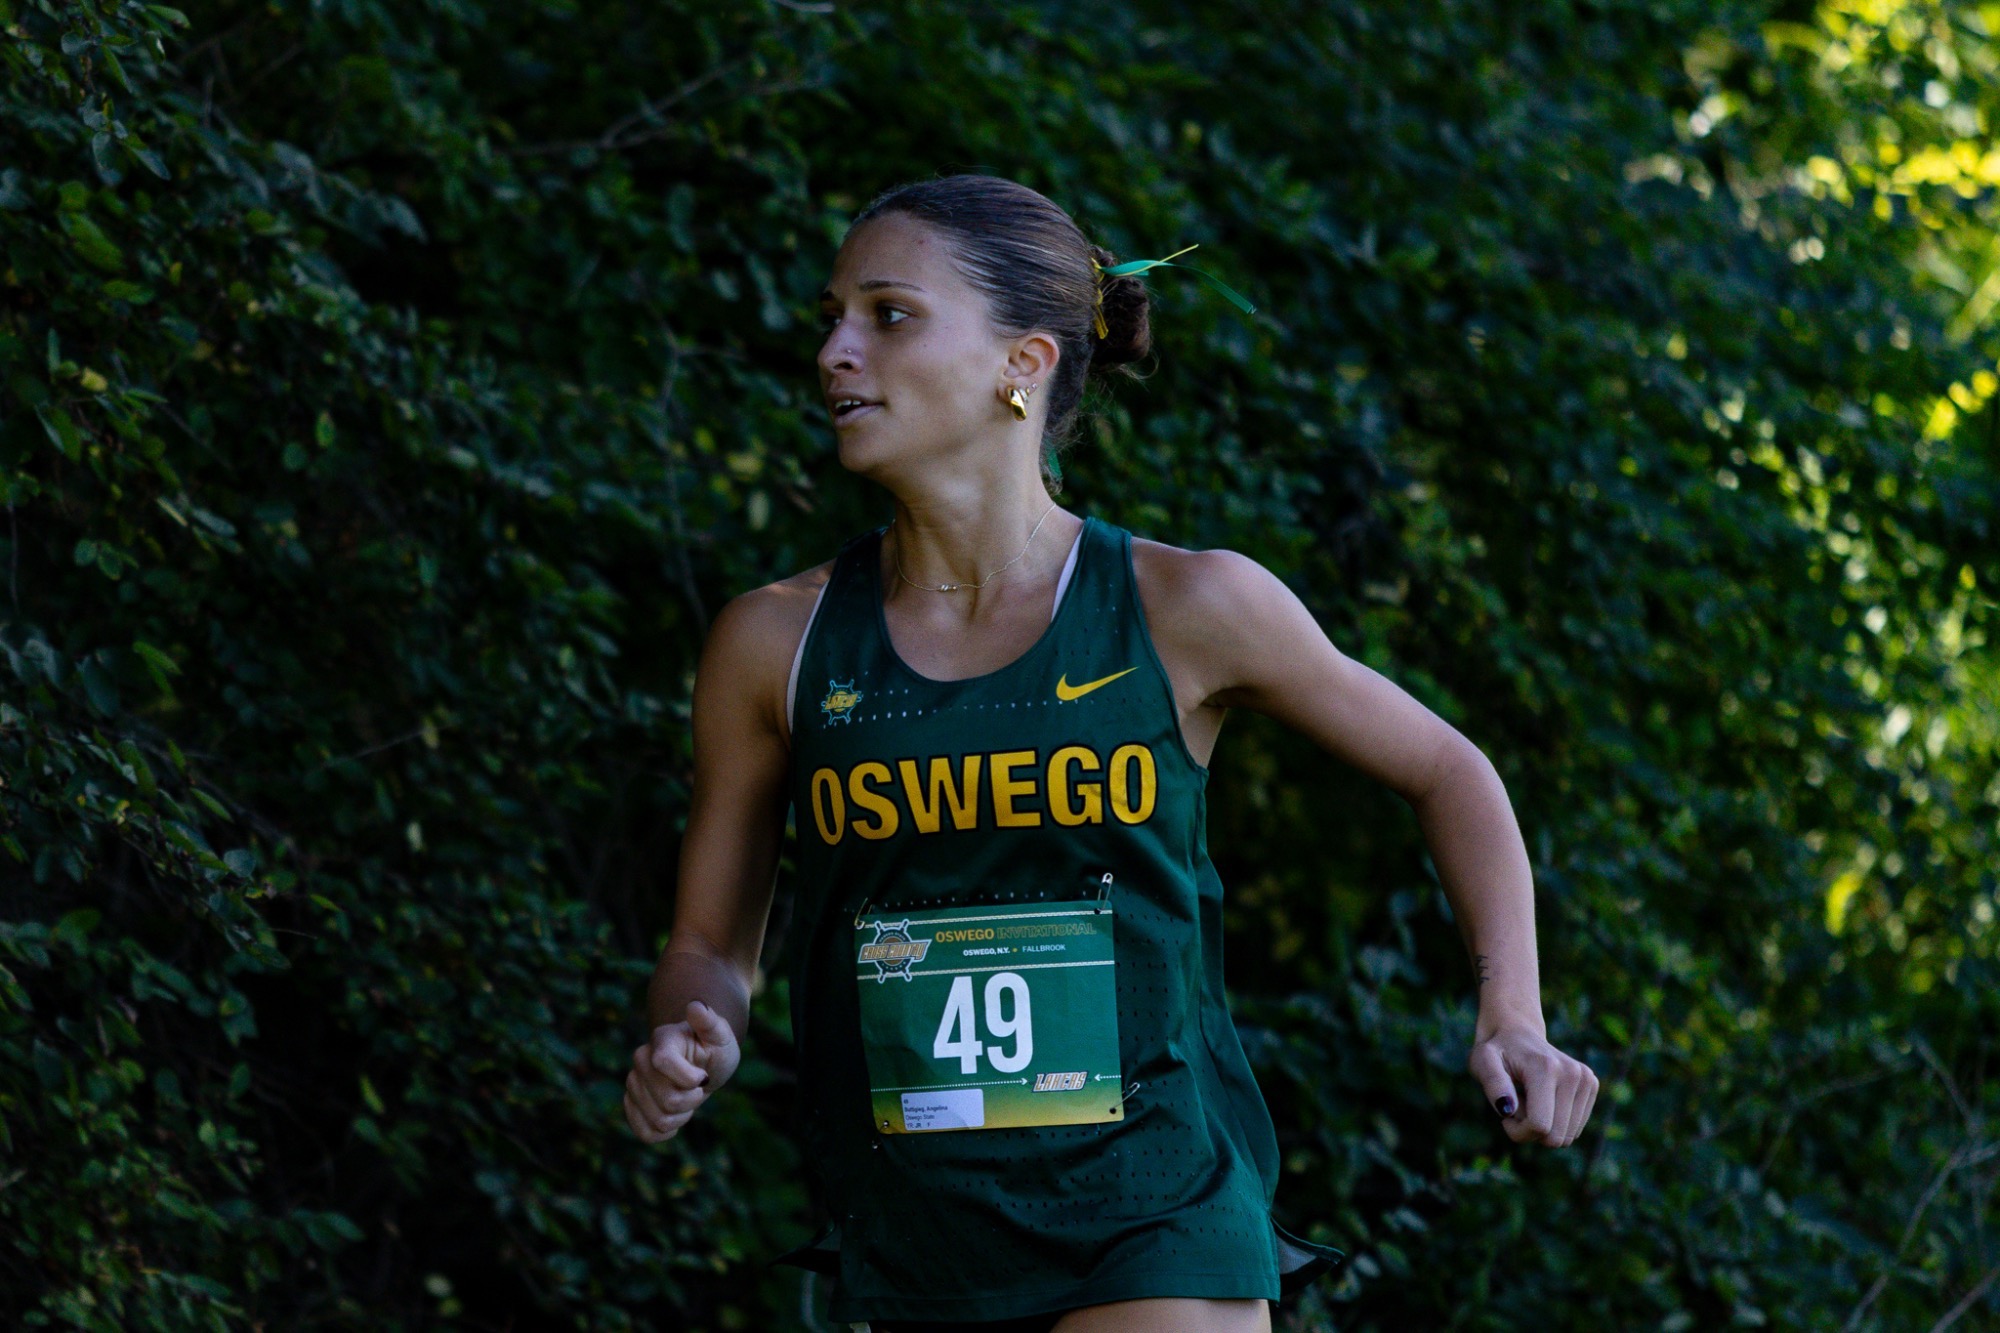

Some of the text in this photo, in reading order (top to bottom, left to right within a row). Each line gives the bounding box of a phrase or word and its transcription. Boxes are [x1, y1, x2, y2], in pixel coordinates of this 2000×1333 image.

[810, 743, 1158, 846] OSWEGO
[935, 923, 1097, 943] OSWEGO INVITATIONAL
[963, 947, 997, 957] OSWEGO,
[1022, 943, 1067, 953] FALLBROOK
[933, 972, 1034, 1075] 49
[1033, 1071, 1088, 1092] LAKERS
